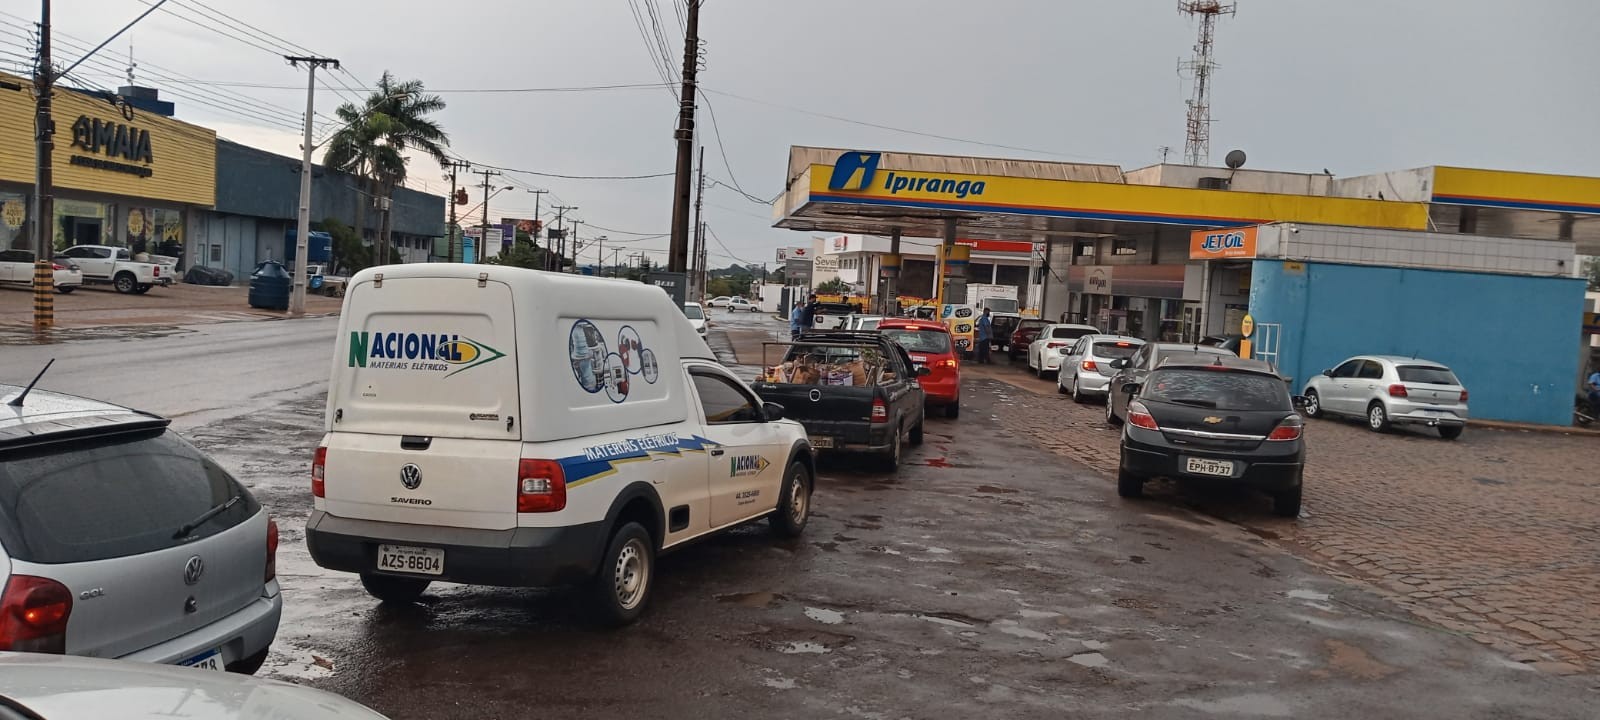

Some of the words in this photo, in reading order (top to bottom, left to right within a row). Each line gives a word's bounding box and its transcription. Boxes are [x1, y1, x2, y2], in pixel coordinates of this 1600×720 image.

[885, 172, 986, 198] Ipiranga
[1202, 234, 1224, 248] JET
[1225, 233, 1243, 248] OIL
[349, 331, 462, 368] NACIONAL
[370, 361, 408, 370] MATERIAIS
[412, 361, 448, 372] ELÉTRICOS
[583, 440, 639, 460] MATERIAIS
[640, 432, 680, 450] ELÉTRICOS
[730, 455, 760, 477] NACIONAL
[391, 497, 432, 506] SAVEIRO
[80, 588, 104, 600] GOL
